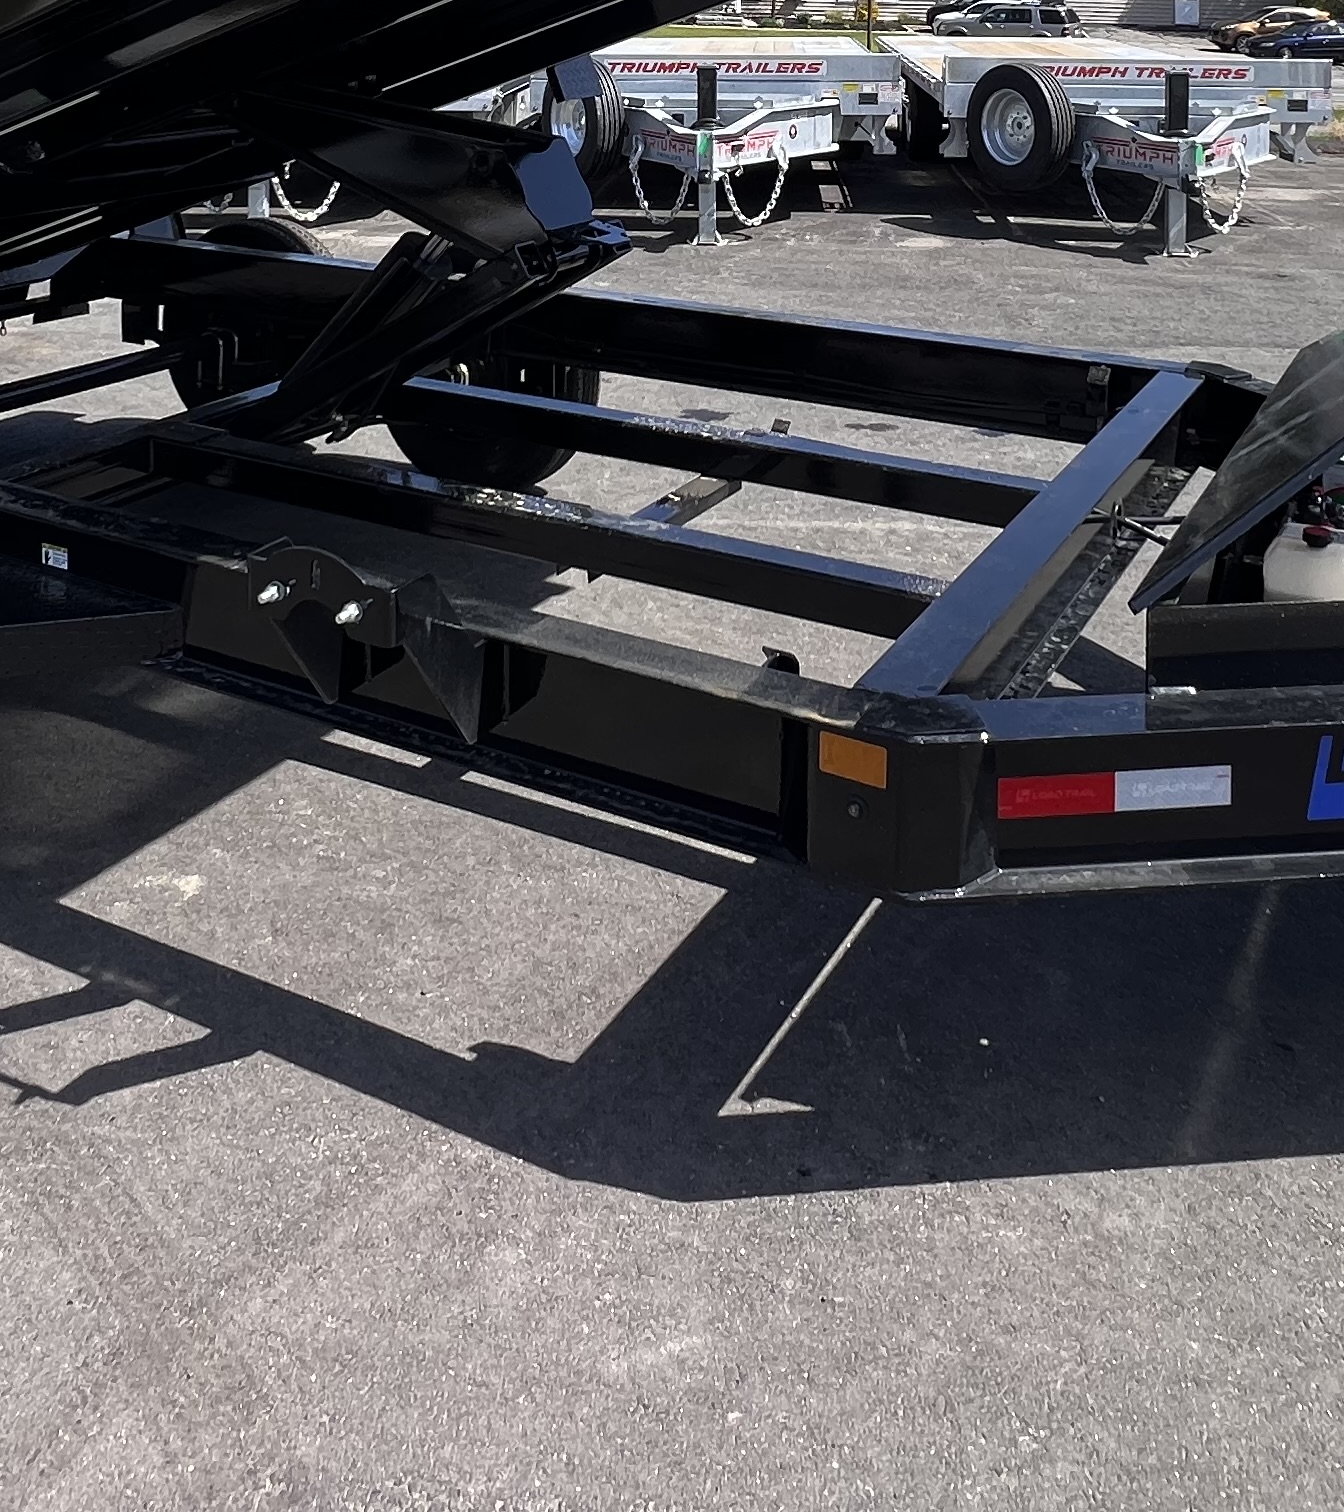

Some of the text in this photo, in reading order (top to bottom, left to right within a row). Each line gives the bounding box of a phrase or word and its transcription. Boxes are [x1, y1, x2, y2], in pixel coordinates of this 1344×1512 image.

[715, 62, 824, 74] TRAILERS
[1042, 65, 1252, 80] RIUMPH TRLERS
[644, 137, 695, 157] RIUMPH
